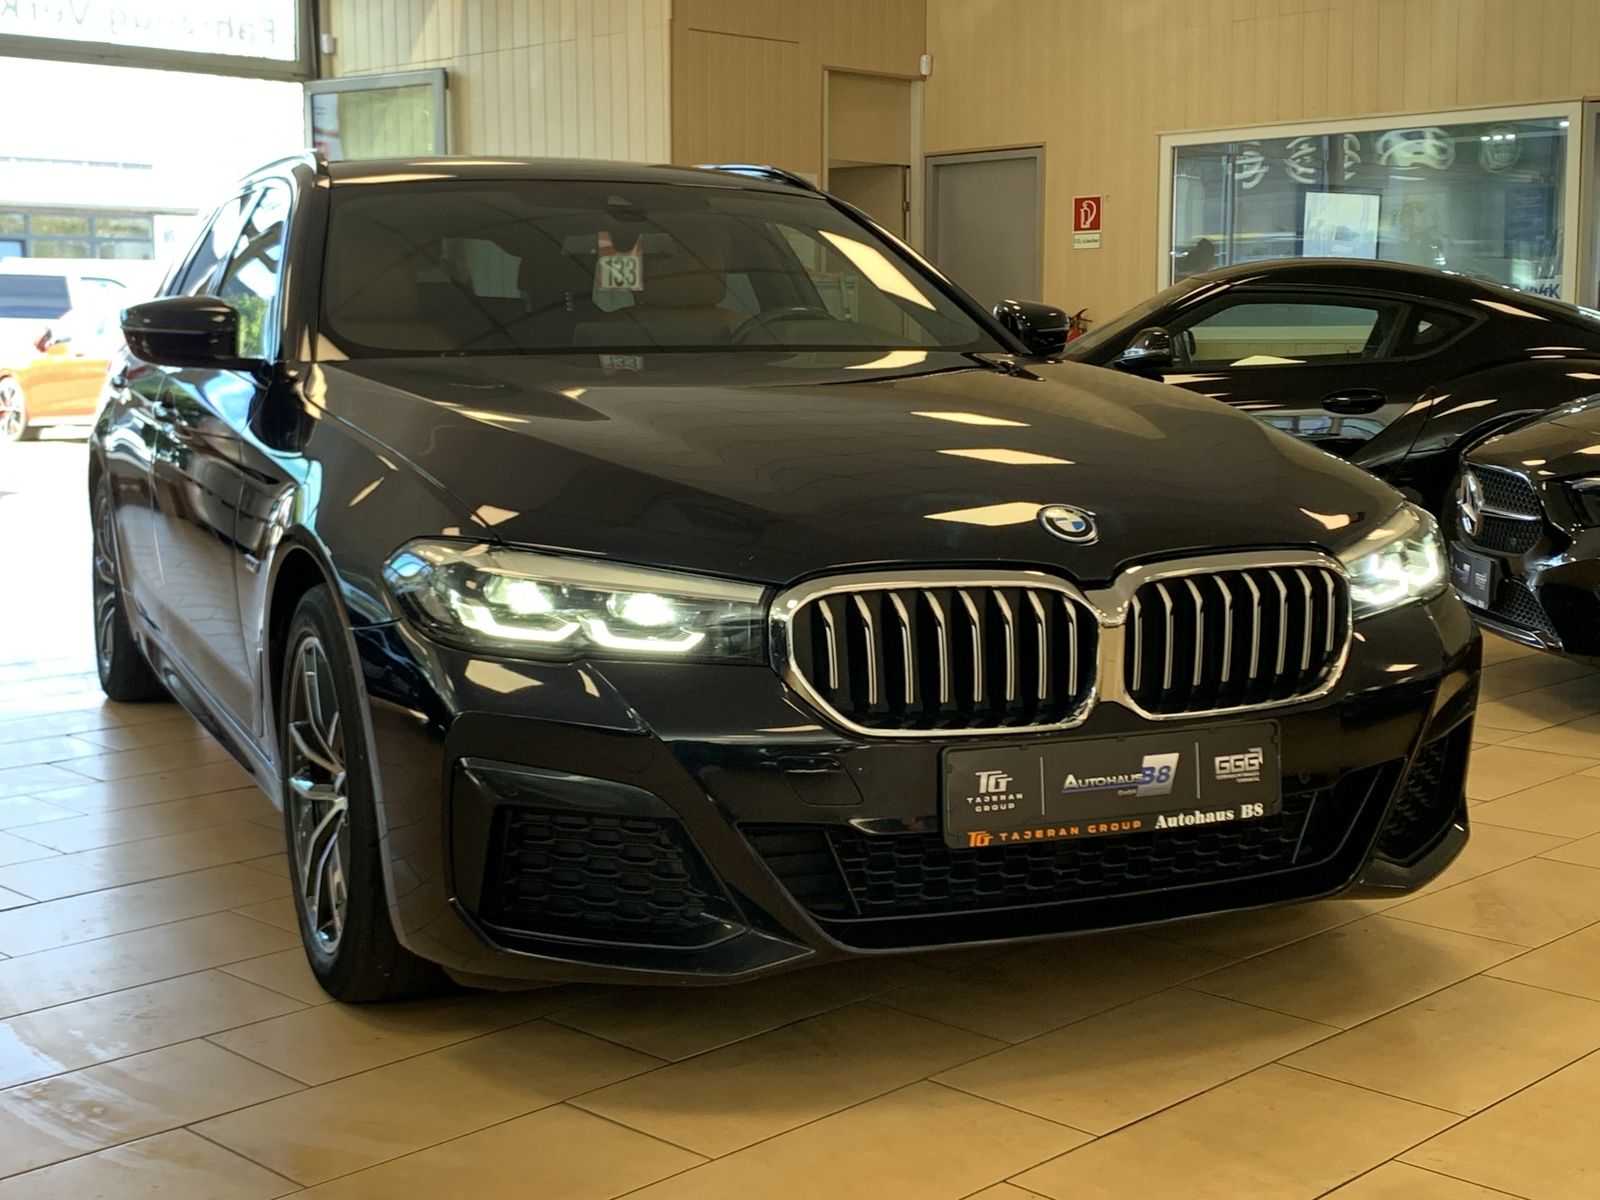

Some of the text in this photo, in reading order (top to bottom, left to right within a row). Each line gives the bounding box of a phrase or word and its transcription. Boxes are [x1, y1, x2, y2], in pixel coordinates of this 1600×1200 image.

[606, 257, 637, 287] 133
[975, 770, 1013, 794] TG
[966, 793, 1023, 804] TAJERAN
[975, 802, 1015, 813] GROUP
[1154, 809, 1235, 829] Autohaus
[999, 826, 1080, 842] TAJERAN
[1087, 820, 1142, 834] GROUP
